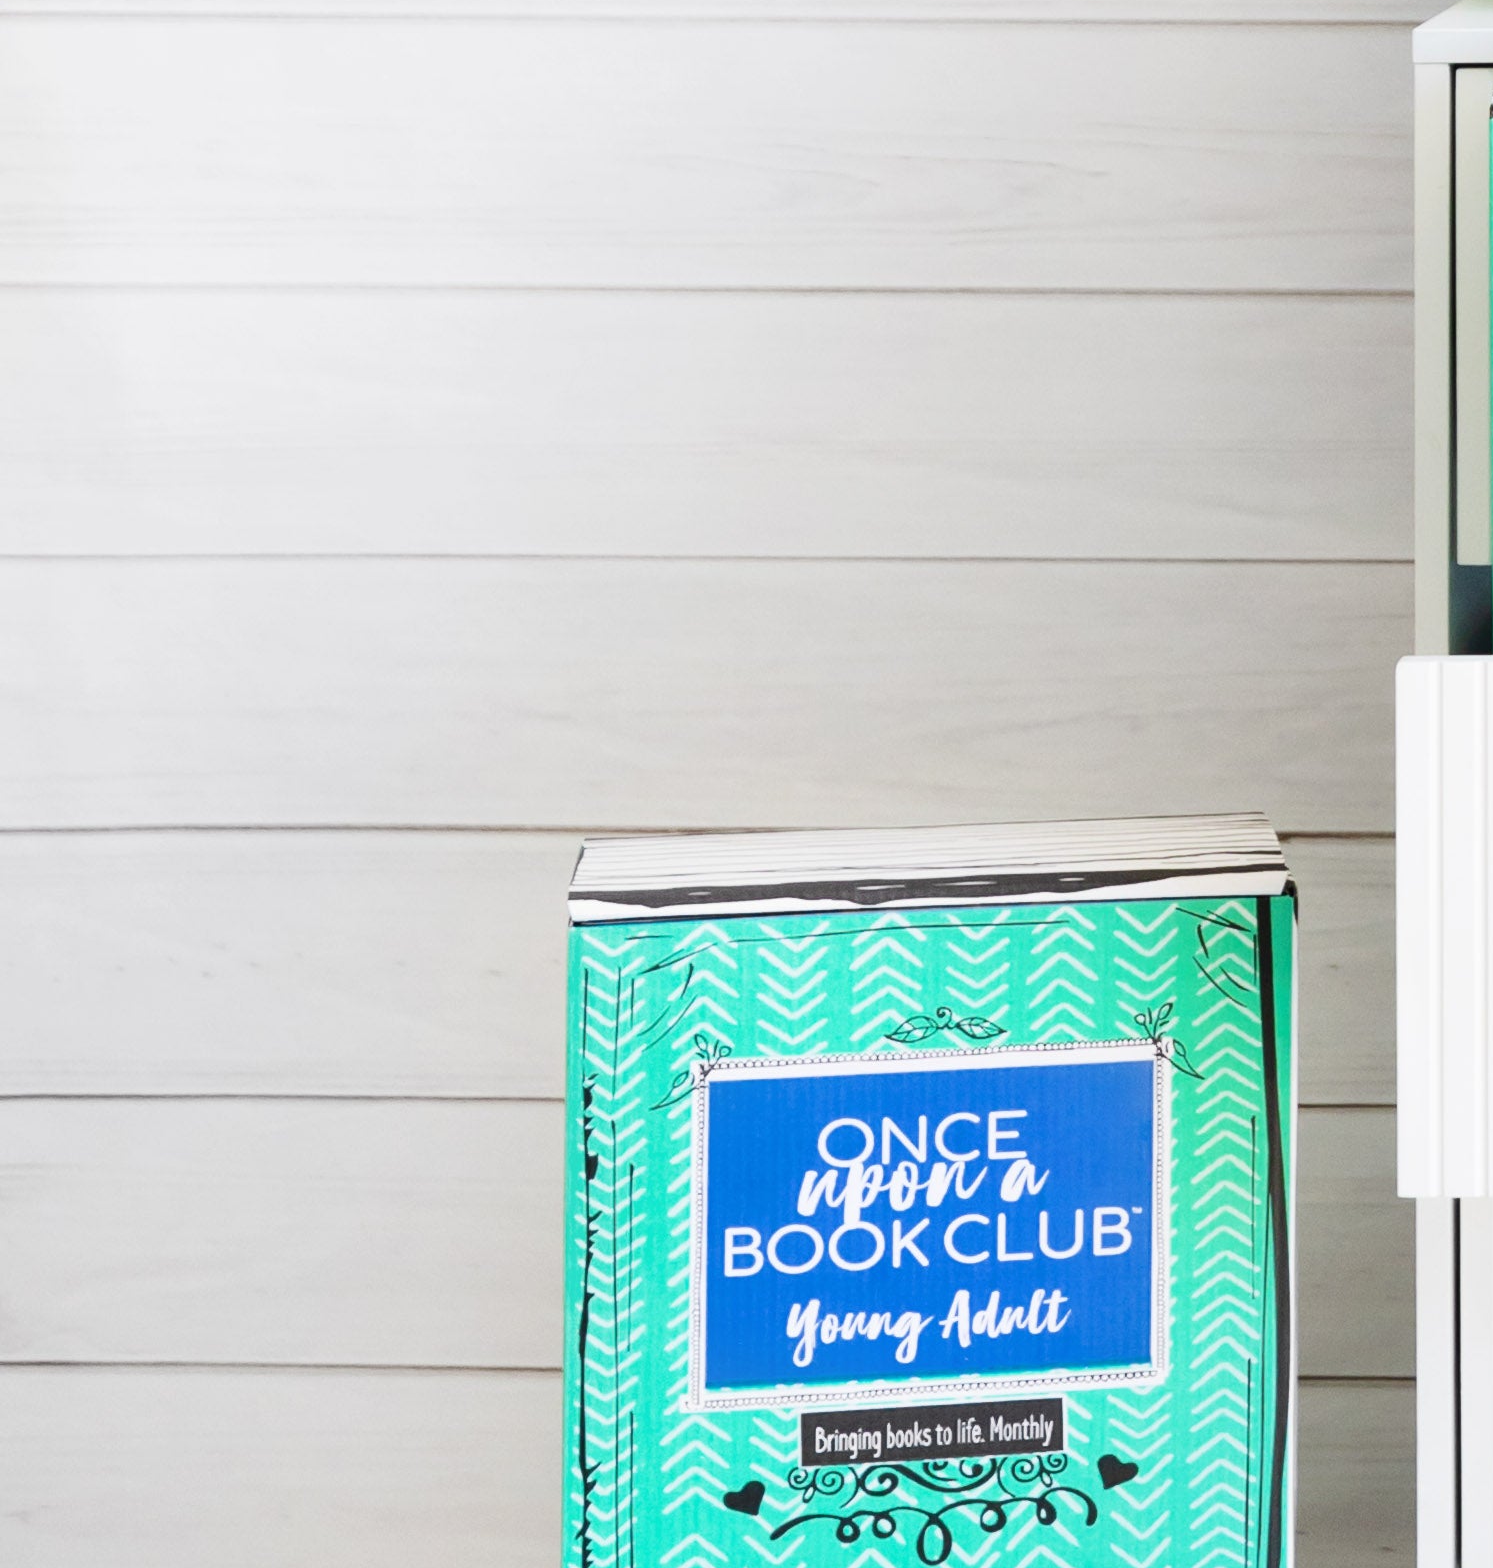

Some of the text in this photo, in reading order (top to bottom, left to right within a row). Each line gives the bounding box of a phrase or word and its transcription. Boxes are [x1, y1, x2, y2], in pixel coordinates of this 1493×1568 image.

[817, 1109, 1028, 1168] ONCE
[797, 1159, 1050, 1226] upon a
[724, 1217, 930, 1278] BOOK
[786, 1288, 1072, 1367] Young Adult
[814, 1413, 1054, 1459] Bringing books to life. Monthly
